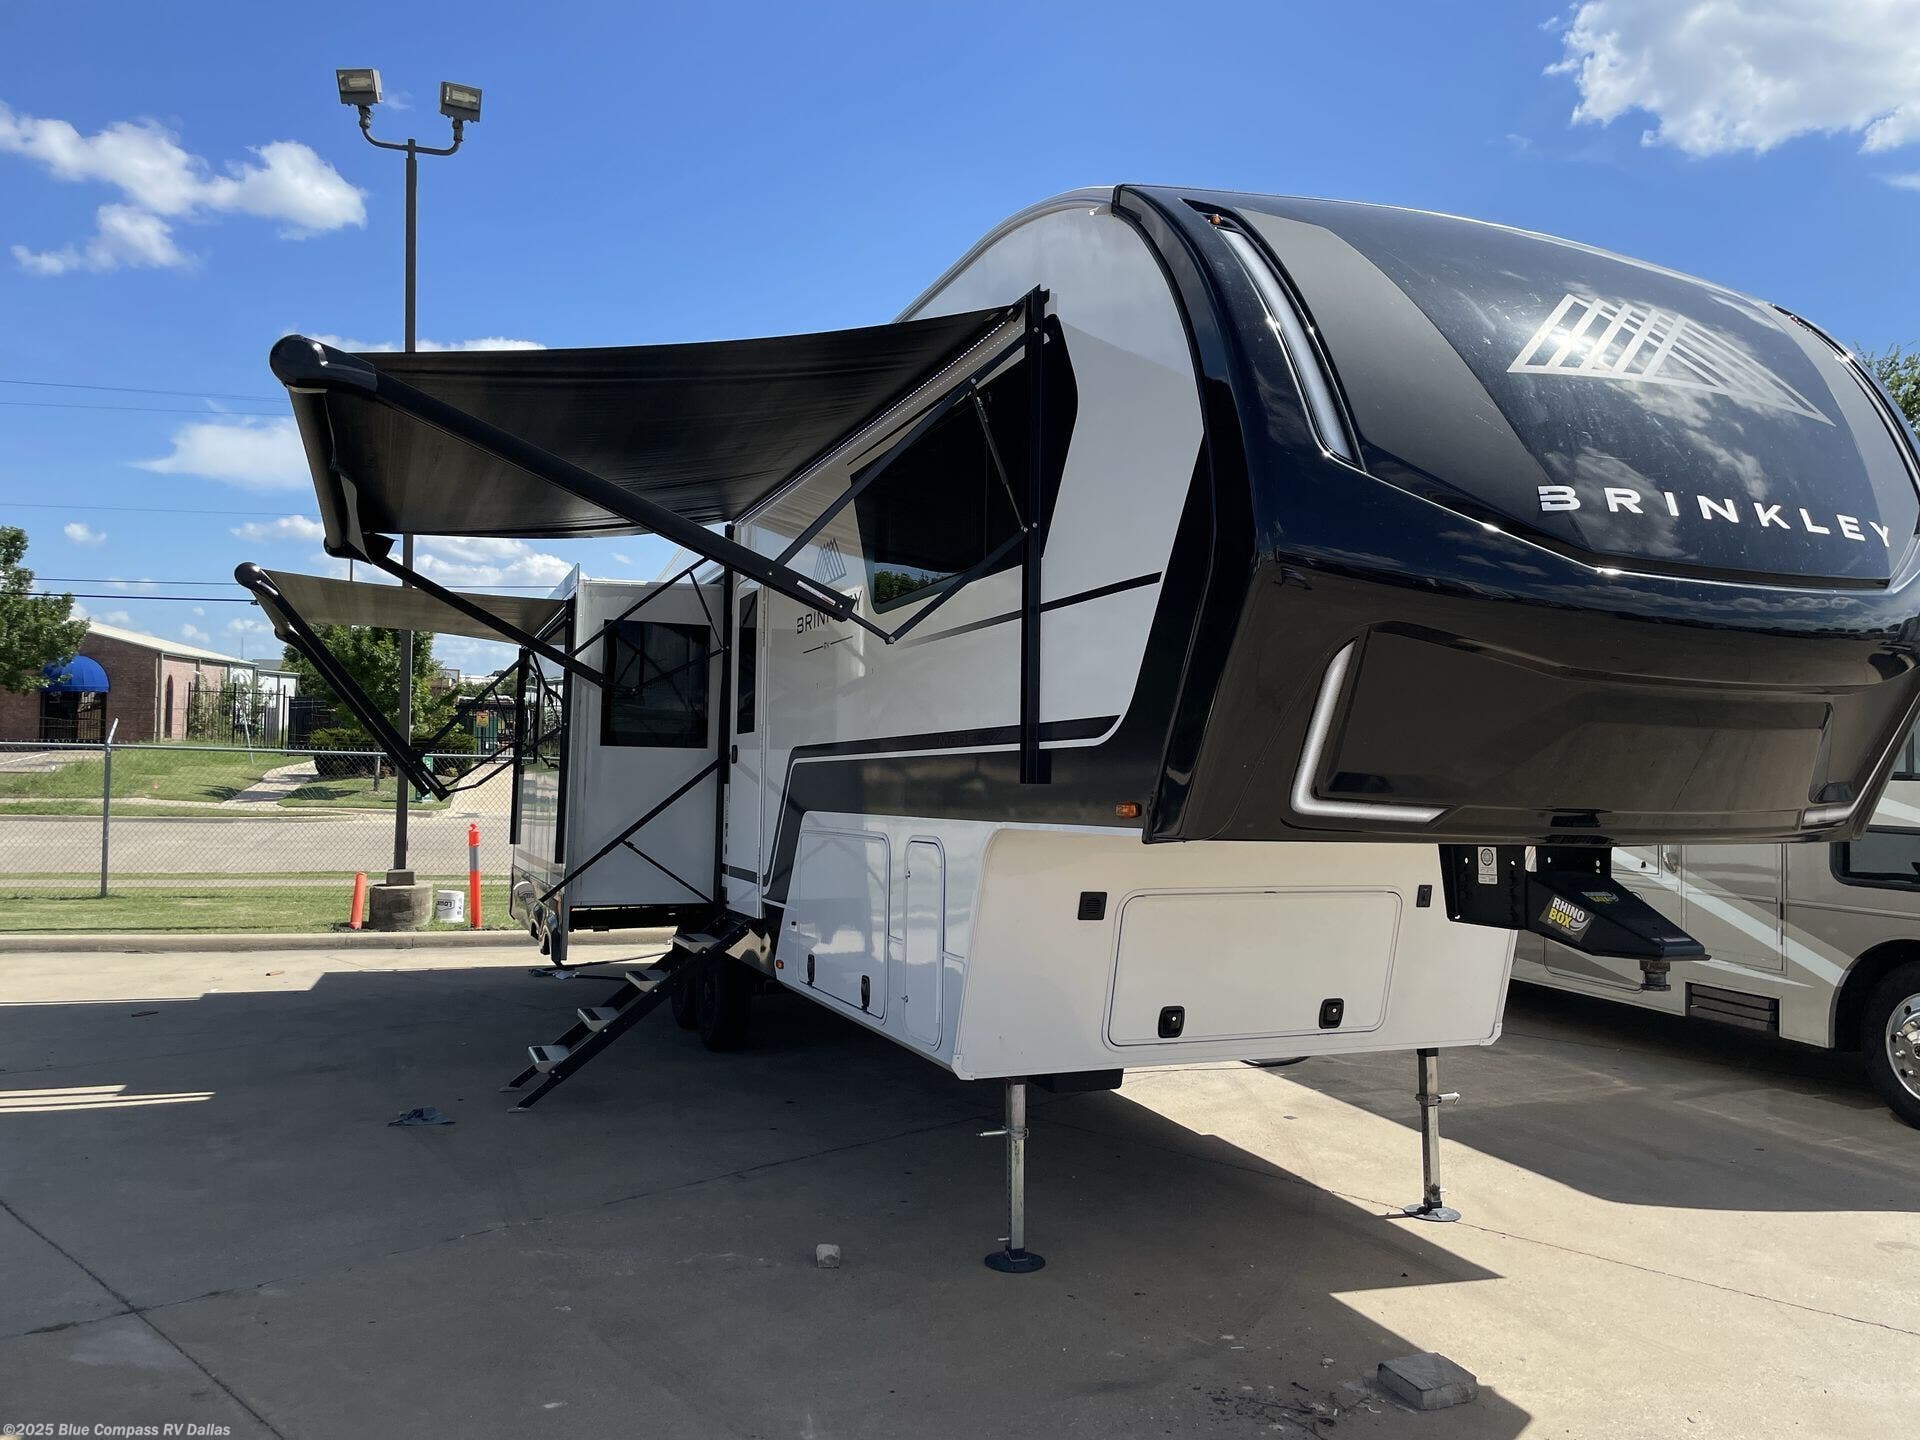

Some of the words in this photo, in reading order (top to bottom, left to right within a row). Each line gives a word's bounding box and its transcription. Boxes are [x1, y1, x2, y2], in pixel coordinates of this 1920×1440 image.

[1537, 484, 1891, 548] BRINKLEY
[796, 589, 863, 635] BRINY
[1548, 908, 1573, 927] BOX
[1552, 897, 1585, 921] RHINO
